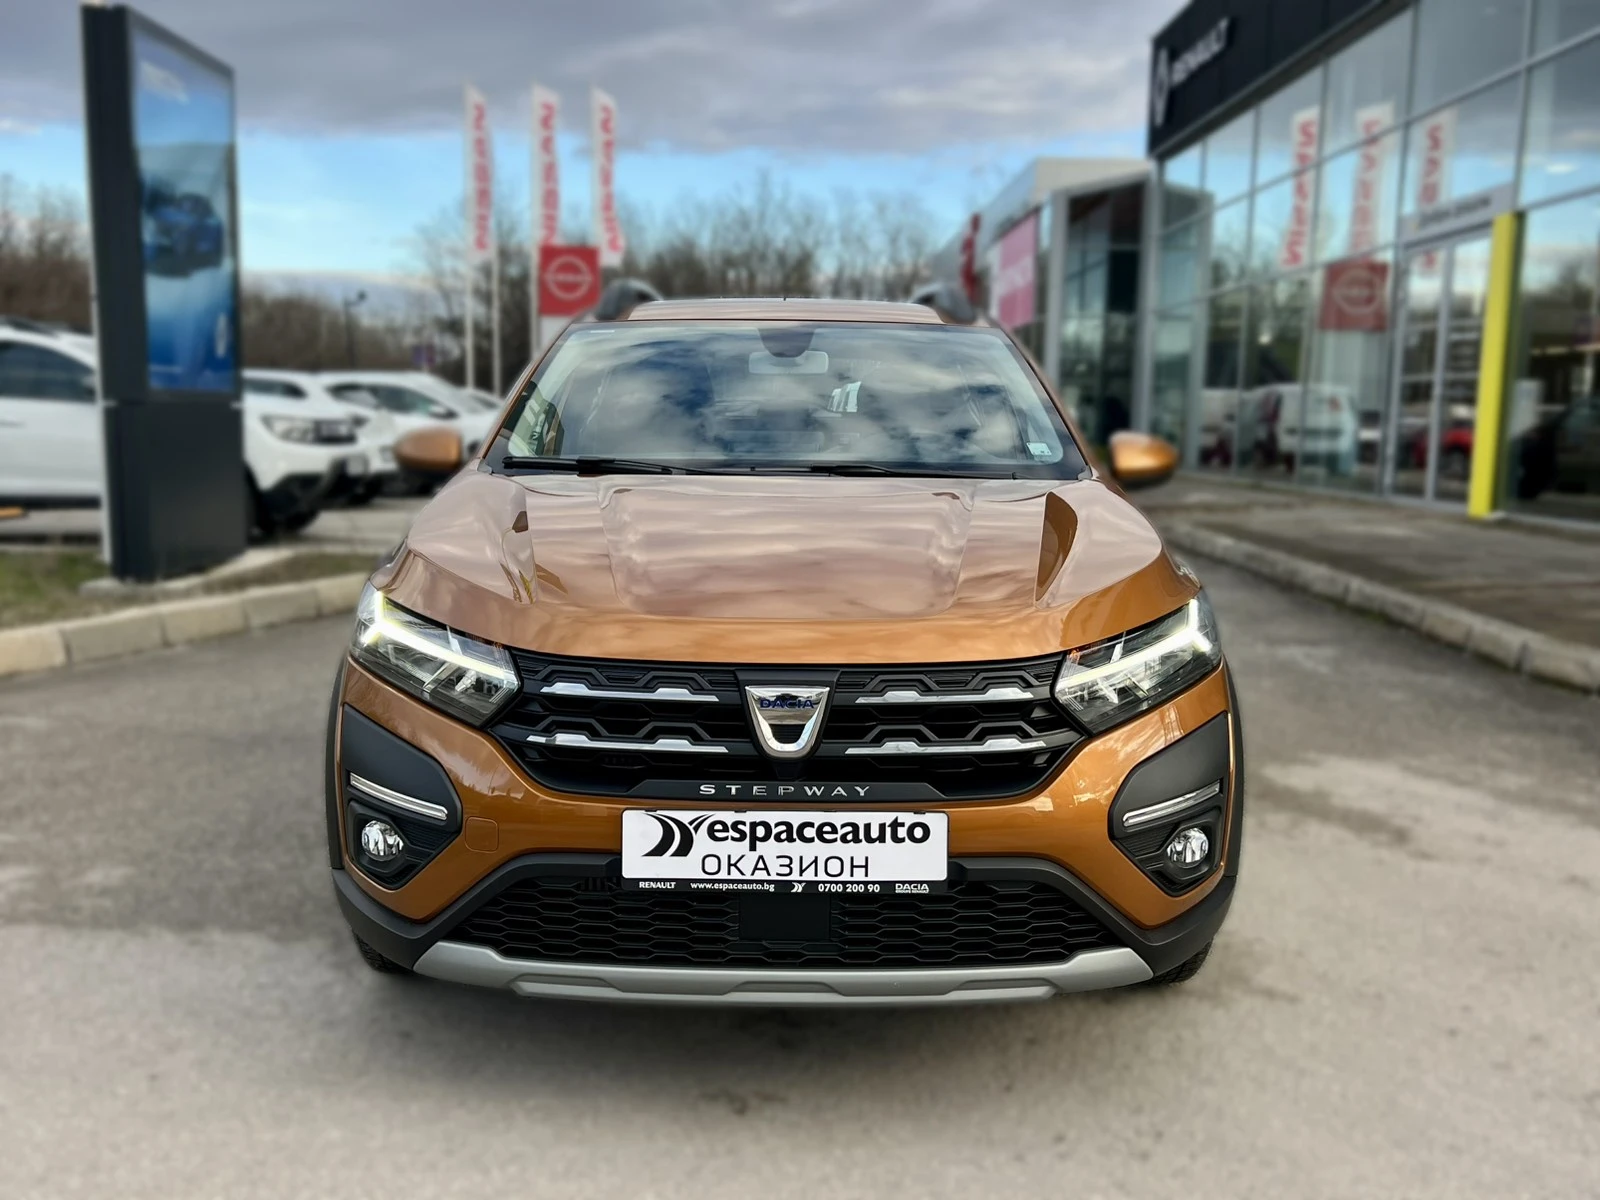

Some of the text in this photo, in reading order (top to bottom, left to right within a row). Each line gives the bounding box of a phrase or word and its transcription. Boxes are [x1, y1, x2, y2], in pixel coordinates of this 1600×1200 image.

[759, 698, 815, 709] DACIA
[699, 784, 871, 797] STEPWAY
[705, 816, 931, 852] espaceauto
[701, 853, 870, 878] ОКАЗИОН
[639, 881, 676, 889] RENAULT
[690, 881, 775, 892] www.espaceauto.bg
[818, 883, 843, 893] 0700
[845, 883, 865, 893] 200
[867, 883, 881, 893] 90
